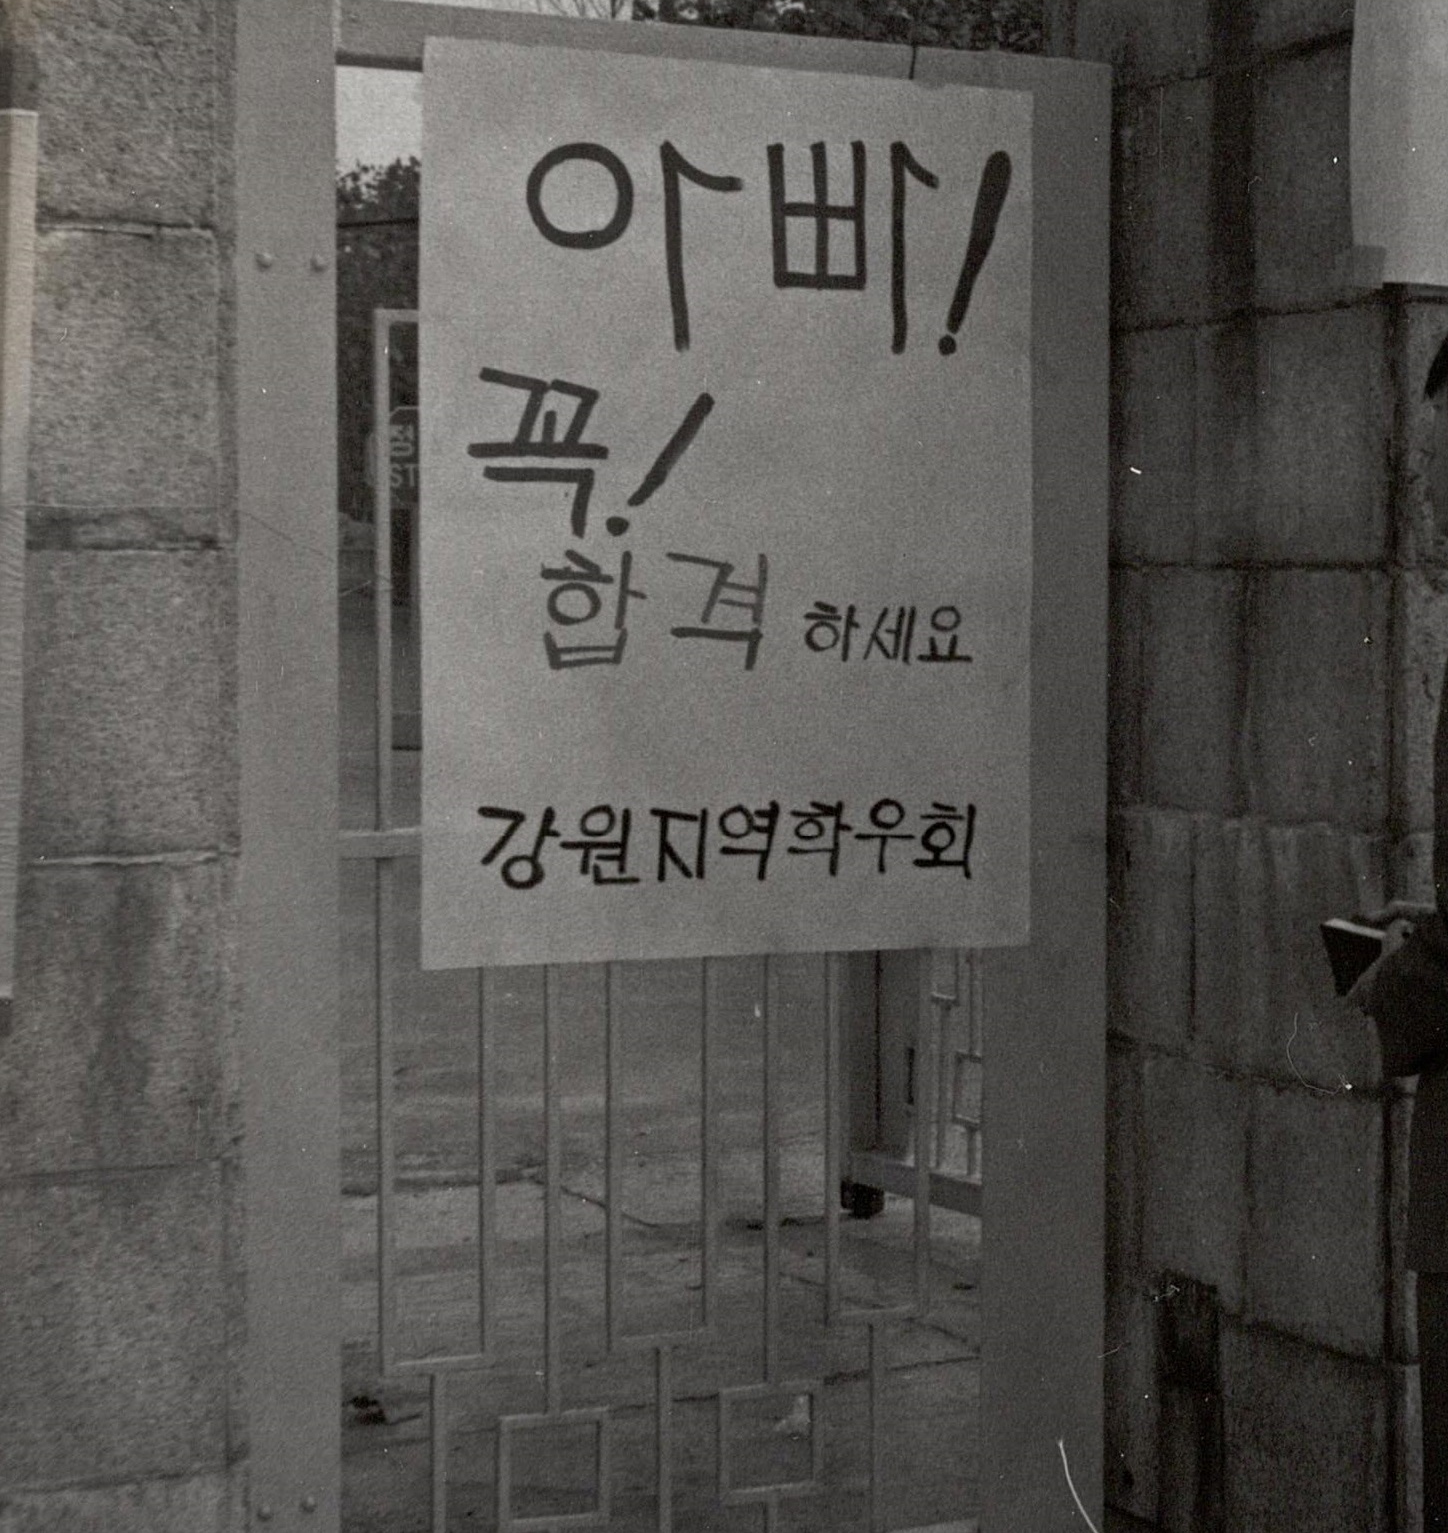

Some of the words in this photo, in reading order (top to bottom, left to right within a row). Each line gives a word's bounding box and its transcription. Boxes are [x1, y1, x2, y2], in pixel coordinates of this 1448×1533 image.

[526, 139, 1012, 356] 아빠!
[467, 367, 715, 537] 꼭!
[540, 549, 767, 670] 합격
[803, 600, 973, 664] 하세요
[477, 799, 977, 891] 강원지역학우회
